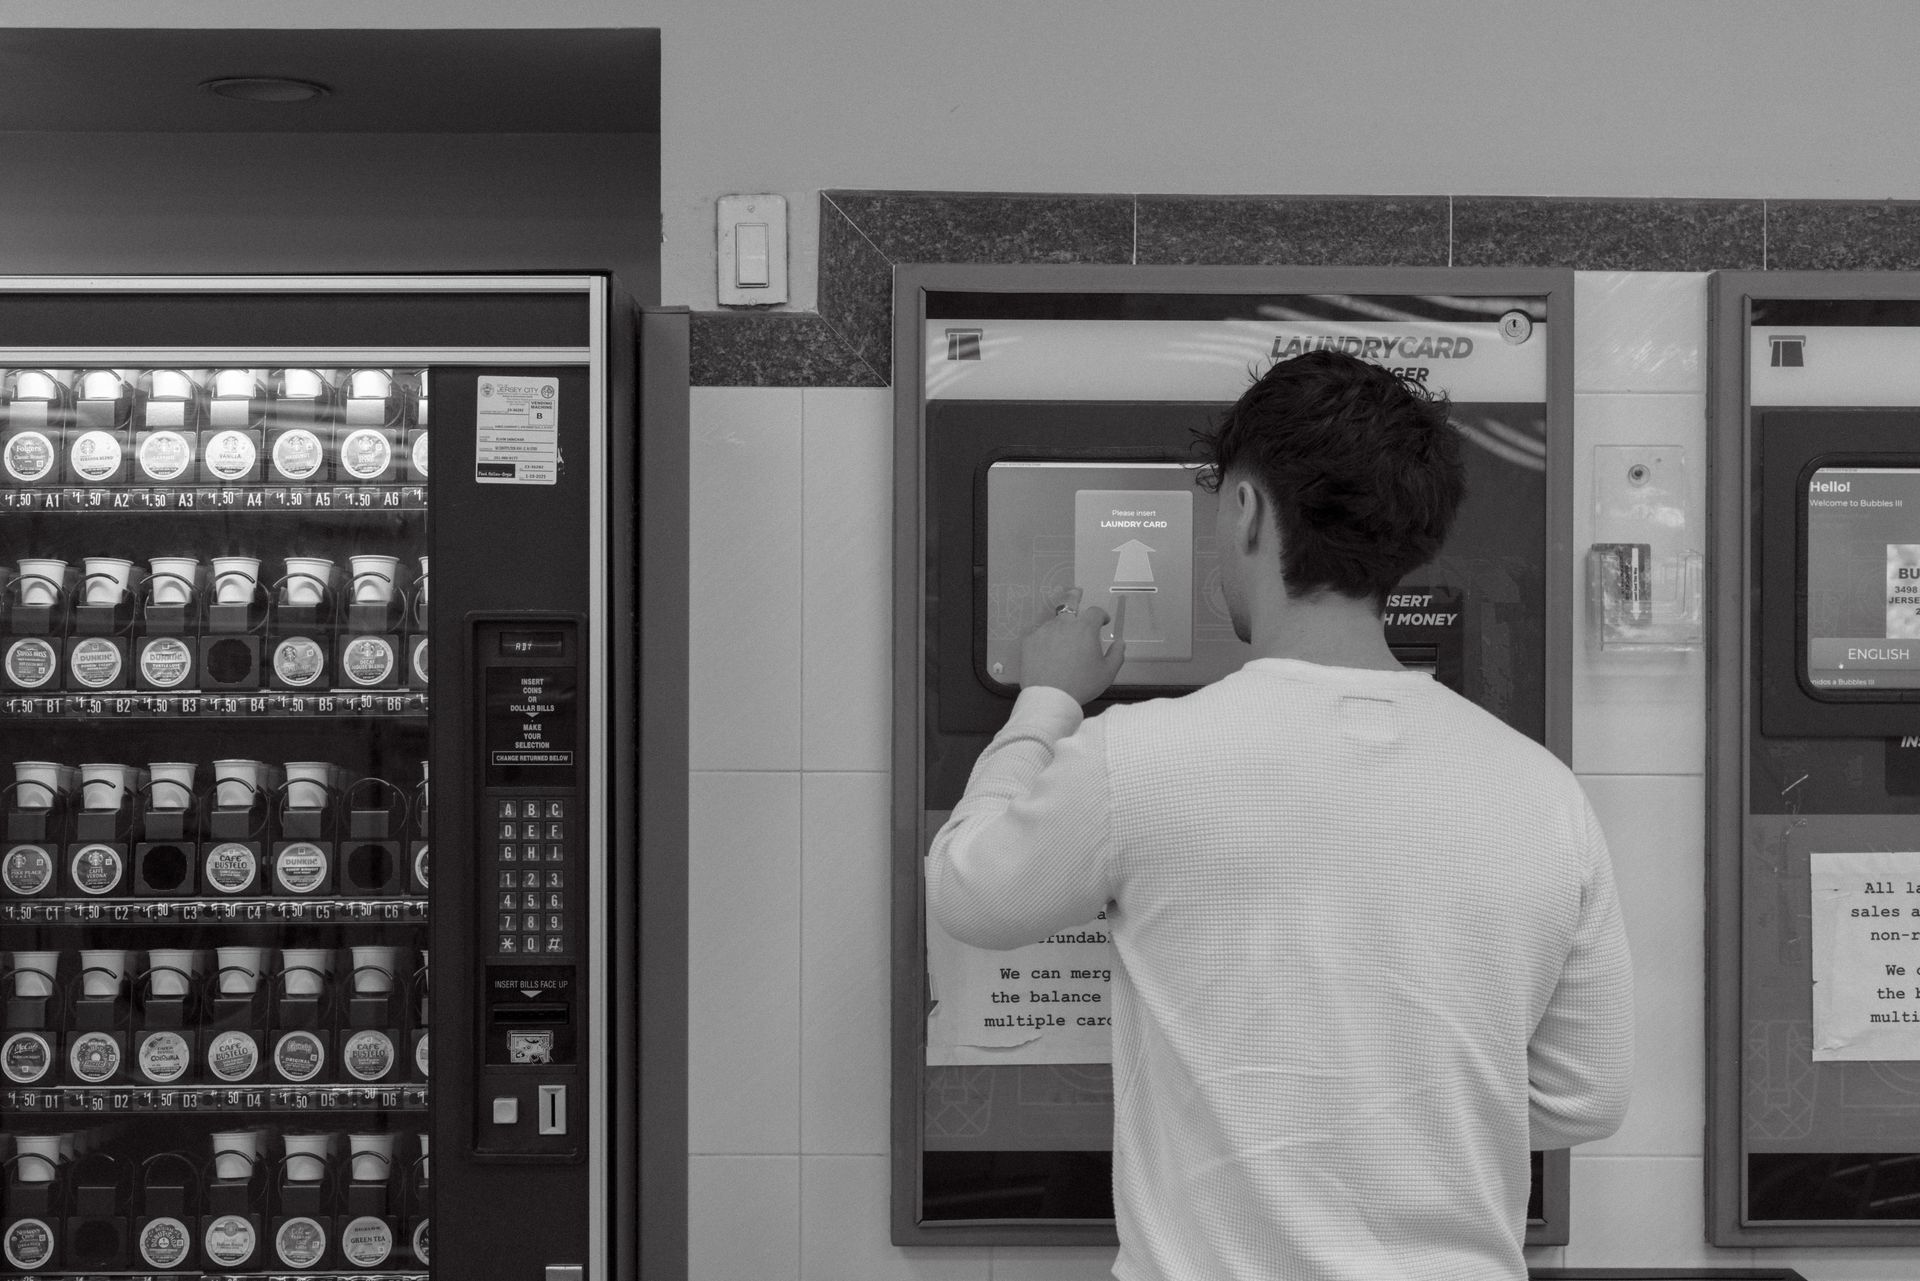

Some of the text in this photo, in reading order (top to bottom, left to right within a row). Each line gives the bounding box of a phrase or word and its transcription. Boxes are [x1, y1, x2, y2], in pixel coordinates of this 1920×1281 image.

[1271, 336, 1474, 359] LAUNDRYCARD
[1810, 482, 1850, 492] Hello!
[45, 494, 60, 508] A1
[114, 494, 129, 507] A2
[178, 493, 193, 507] A3
[247, 492, 262, 506] A4
[316, 492, 330, 506] A5
[384, 492, 399, 506] A6
[1894, 586, 1918, 594] 3498
[1397, 614, 1458, 626] MONEY
[1848, 648, 1910, 660] ENGLISH
[47, 700, 60, 713] B1
[116, 700, 130, 712] B2
[182, 699, 196, 712] B3
[251, 698, 264, 712] B4
[319, 698, 333, 712] B5
[388, 697, 401, 711] B6
[505, 804, 512, 816] A
[528, 804, 536, 816] B
[552, 804, 558, 816] C
[504, 825, 512, 837] D
[528, 825, 535, 837] E
[552, 825, 558, 837] F
[504, 846, 512, 858] G
[528, 846, 535, 858] H
[552, 846, 557, 858] J
[506, 873, 510, 886] 1
[528, 873, 534, 886] 2
[552, 873, 558, 886] 3
[1864, 882, 1894, 894] All
[504, 894, 511, 907] 4
[528, 894, 534, 907] 5
[552, 894, 558, 907] 6
[46, 907, 59, 920] C1
[115, 907, 128, 920] C2
[184, 906, 197, 920] C3
[247, 905, 261, 920] C4
[316, 905, 330, 919] C5
[384, 904, 398, 918] C6
[1850, 906, 1900, 918] sales
[504, 916, 510, 928] 7
[528, 916, 534, 928] 8
[551, 916, 558, 928] 9
[528, 938, 534, 950] 0
[548, 938, 560, 950] #
[1000, 968, 1112, 982] We can merg
[1885, 964, 1906, 976] We
[495, 980, 568, 988] INSERT BILLS FACE UP
[991, 991, 1102, 1004] the balance
[1877, 988, 1906, 1000] the
[984, 1015, 1112, 1030] multiple car
[1870, 1011, 1920, 1023] multi
[216, 1048, 248, 1061] BUSTELO
[352, 1050, 386, 1058] BUSTELO
[45, 1095, 58, 1108] D1
[115, 1094, 128, 1108] D2
[184, 1094, 197, 1108] D3
[247, 1094, 261, 1108] D4
[320, 1093, 335, 1107] D5
[382, 1093, 397, 1107] D6
[350, 1236, 372, 1244] GREEN
